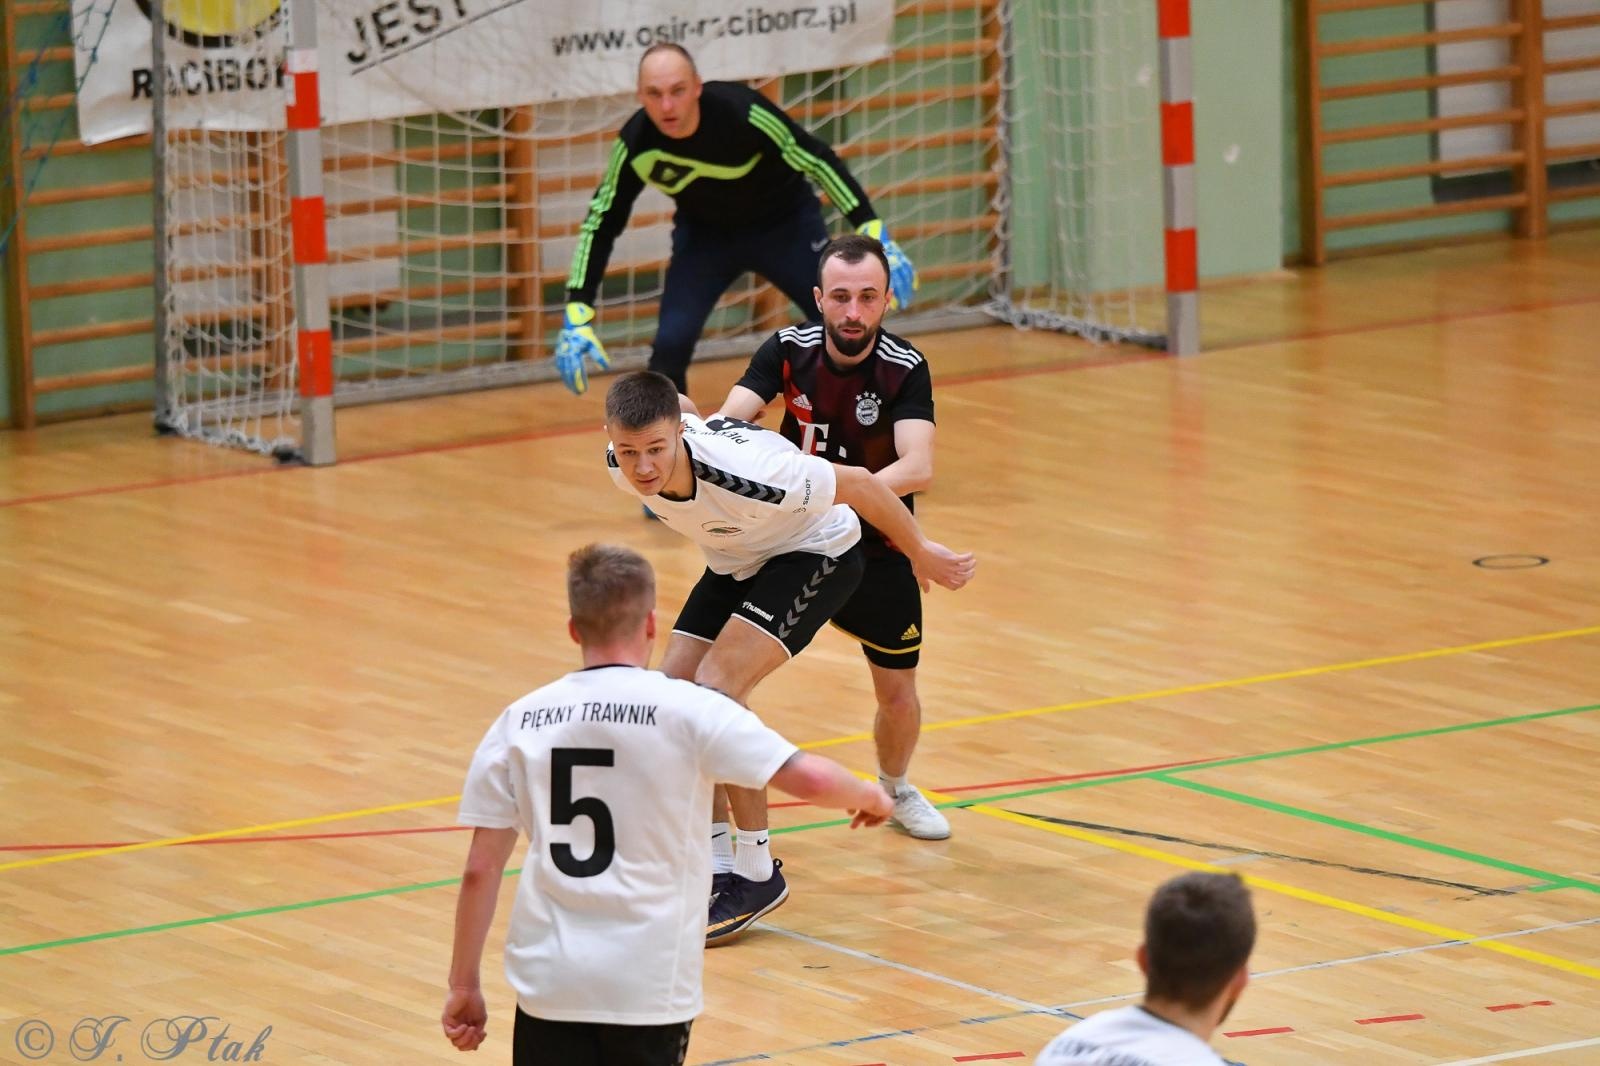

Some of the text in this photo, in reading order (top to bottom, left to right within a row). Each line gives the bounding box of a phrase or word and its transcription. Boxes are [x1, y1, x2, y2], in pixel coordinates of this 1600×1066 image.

[746, 602, 774, 622] hummel
[520, 702, 658, 731] PIĘKNY TRAWNIK
[549, 747, 615, 878] 5
